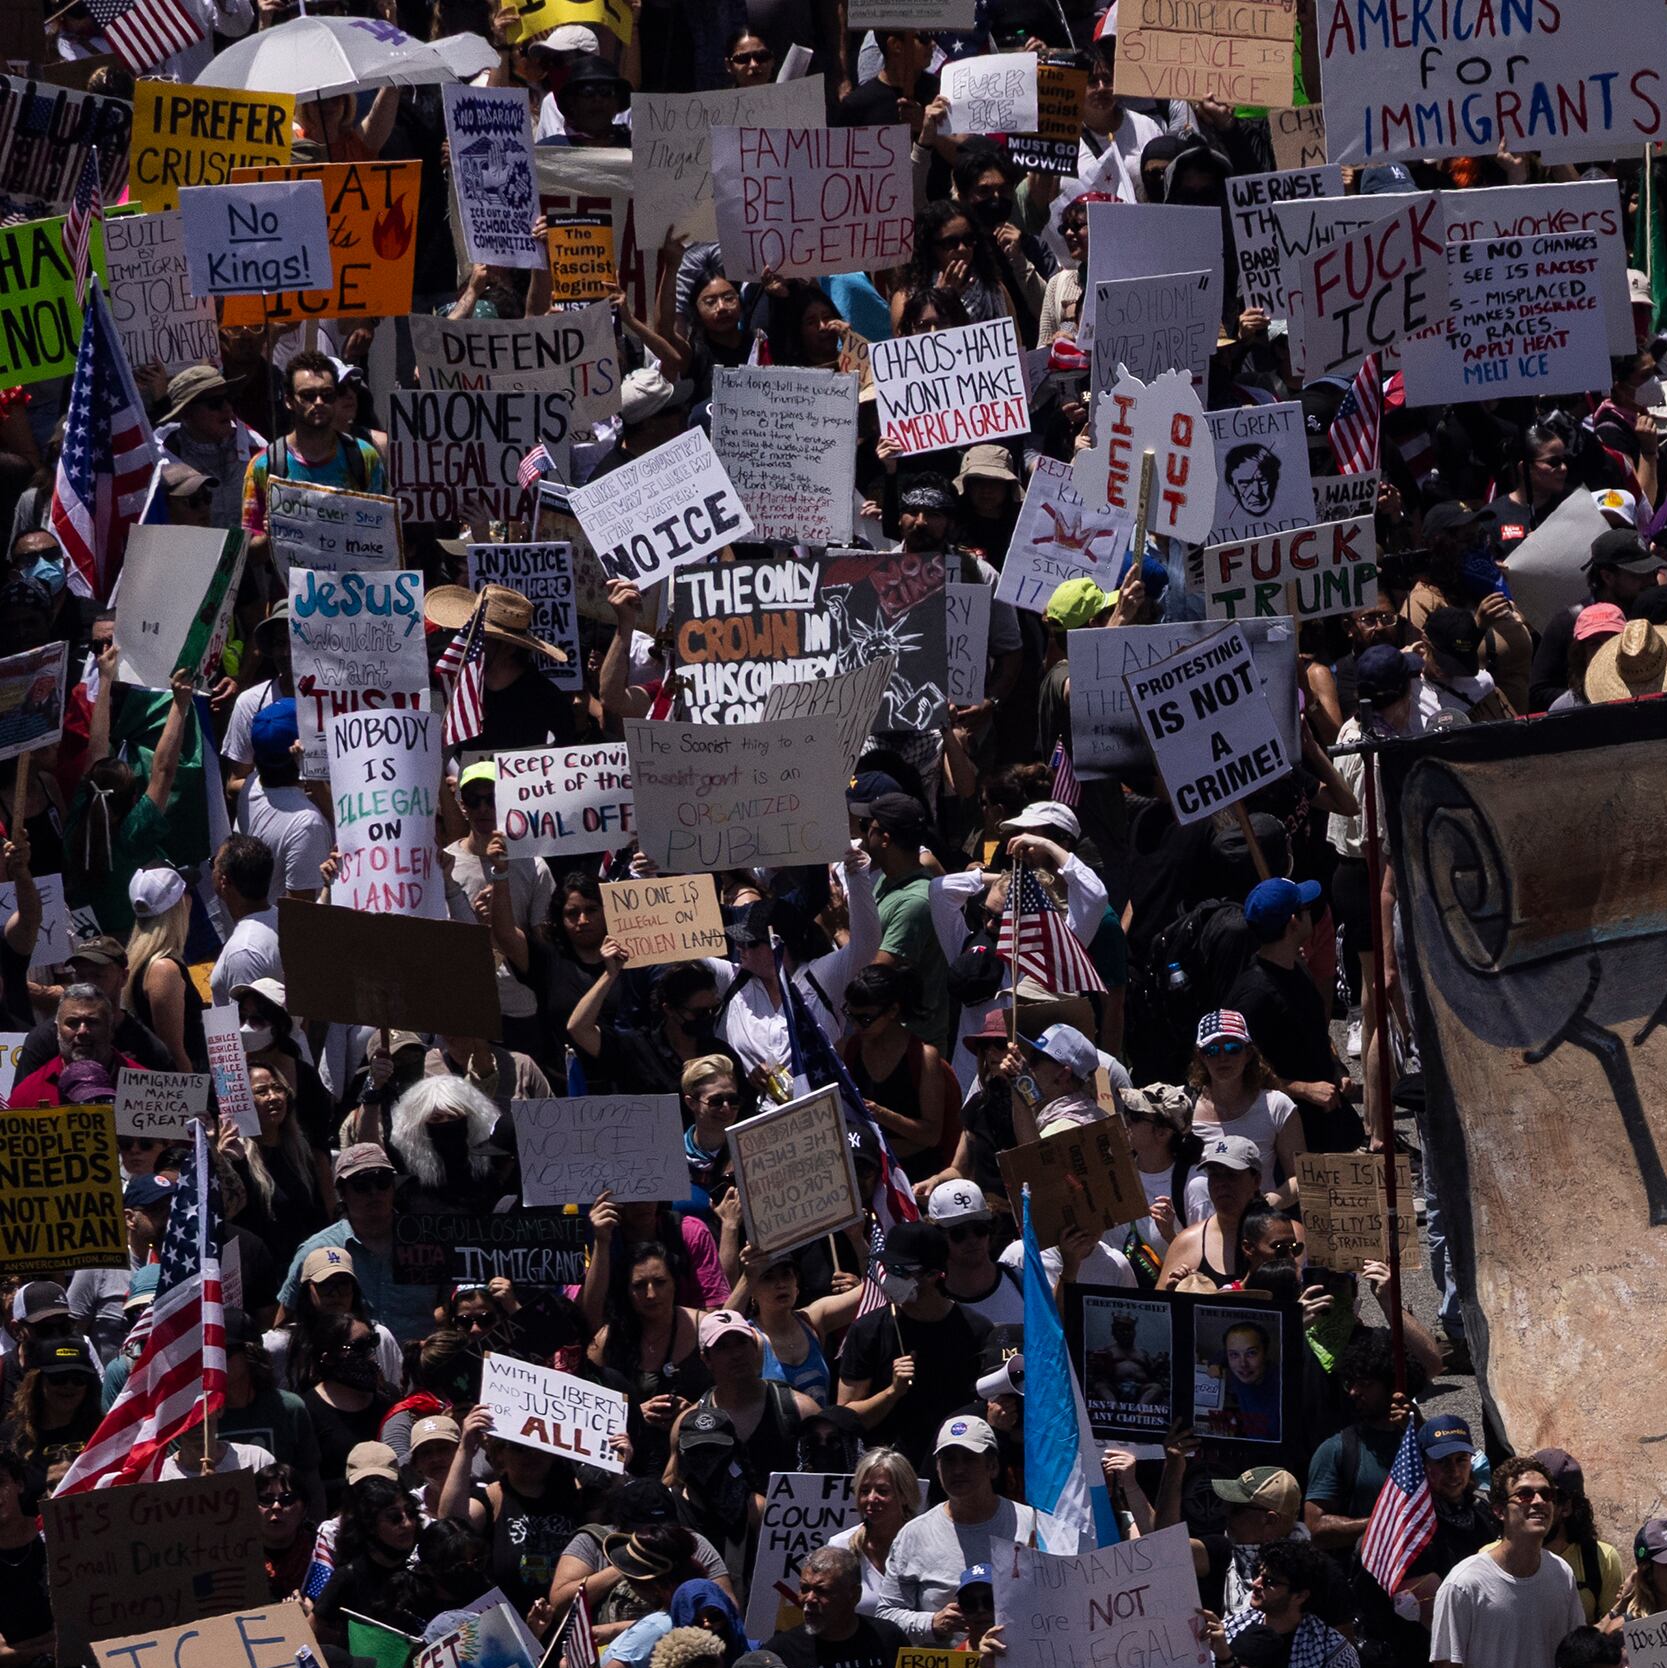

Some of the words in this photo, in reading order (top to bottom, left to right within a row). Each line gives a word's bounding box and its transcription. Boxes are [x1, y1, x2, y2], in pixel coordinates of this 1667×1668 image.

[1326, 0, 1560, 58] AMERICANS
[153, 97, 163, 134] I
[170, 97, 286, 147] PREFER
[1365, 69, 1661, 156] IMMIGRANTS
[227, 203, 278, 236] No
[470, 208, 485, 218] ICE
[487, 209, 502, 218] OUT
[503, 209, 512, 219] OF
[473, 219, 519, 234] SCHOOLS
[474, 237, 536, 252] COMMUNITIES
[208, 246, 310, 287] Kings!
[1137, 635, 1243, 700] PROTESTING
[1147, 701, 1185, 740] IS
[1189, 662, 1254, 721] NOT
[1210, 731, 1233, 762] A
[1177, 739, 1282, 814] CRIME!
[122, 1071, 204, 1089] IMMIGRANTS
[145, 1090, 184, 1099] MAKE
[124, 1100, 188, 1112] AMERICA
[132, 1113, 190, 1130] GREAT
